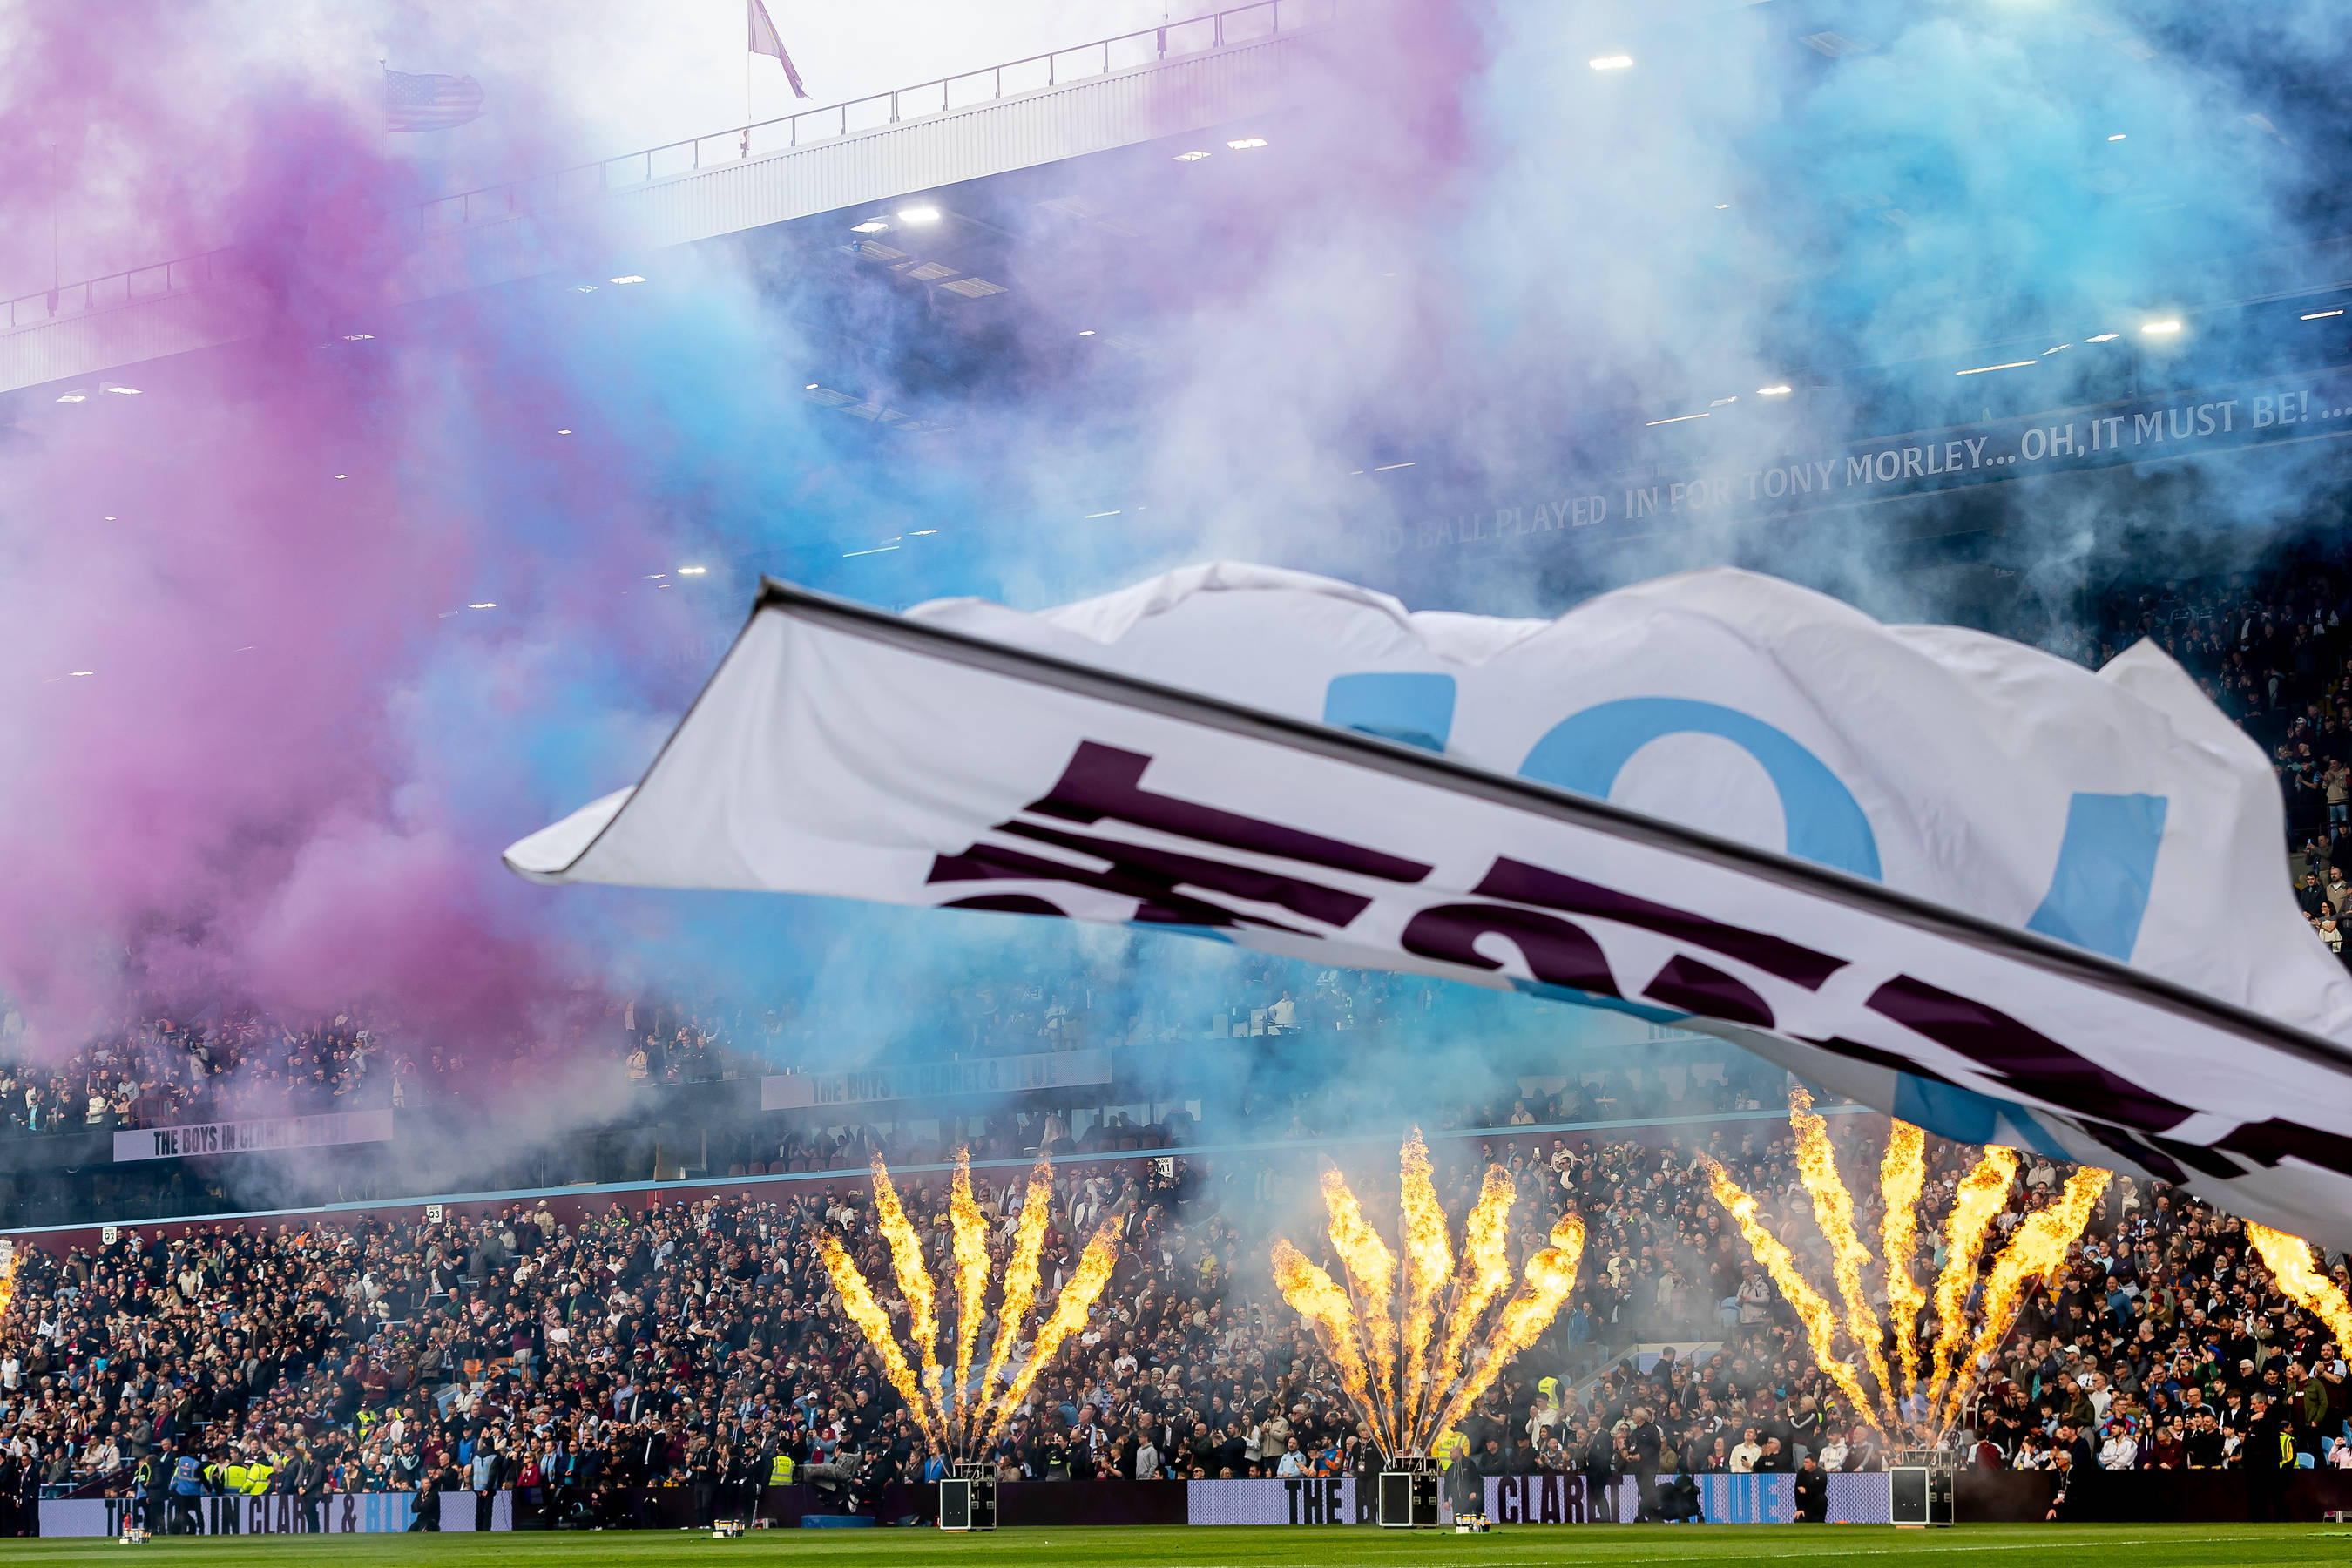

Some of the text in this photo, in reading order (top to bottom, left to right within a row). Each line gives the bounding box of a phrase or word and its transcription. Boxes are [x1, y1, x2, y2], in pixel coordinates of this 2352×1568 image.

[1416, 513, 1486, 550] BALL
[1496, 495, 1606, 537] PLAYED
[1625, 486, 1658, 519] IN
[1669, 476, 1732, 512] FOR
[1744, 459, 1836, 502] TONY
[2134, 400, 2239, 445] MUST
[153, 1129, 178, 1156] THE
[183, 1125, 217, 1153] BOYS
[221, 1125, 235, 1150] IN
[429, 1210, 440, 1219] Q3
[211, 1497, 240, 1535] IN
[249, 1493, 333, 1534] CLART
[341, 1493, 357, 1533] &
[1285, 1480, 1342, 1524] THE
